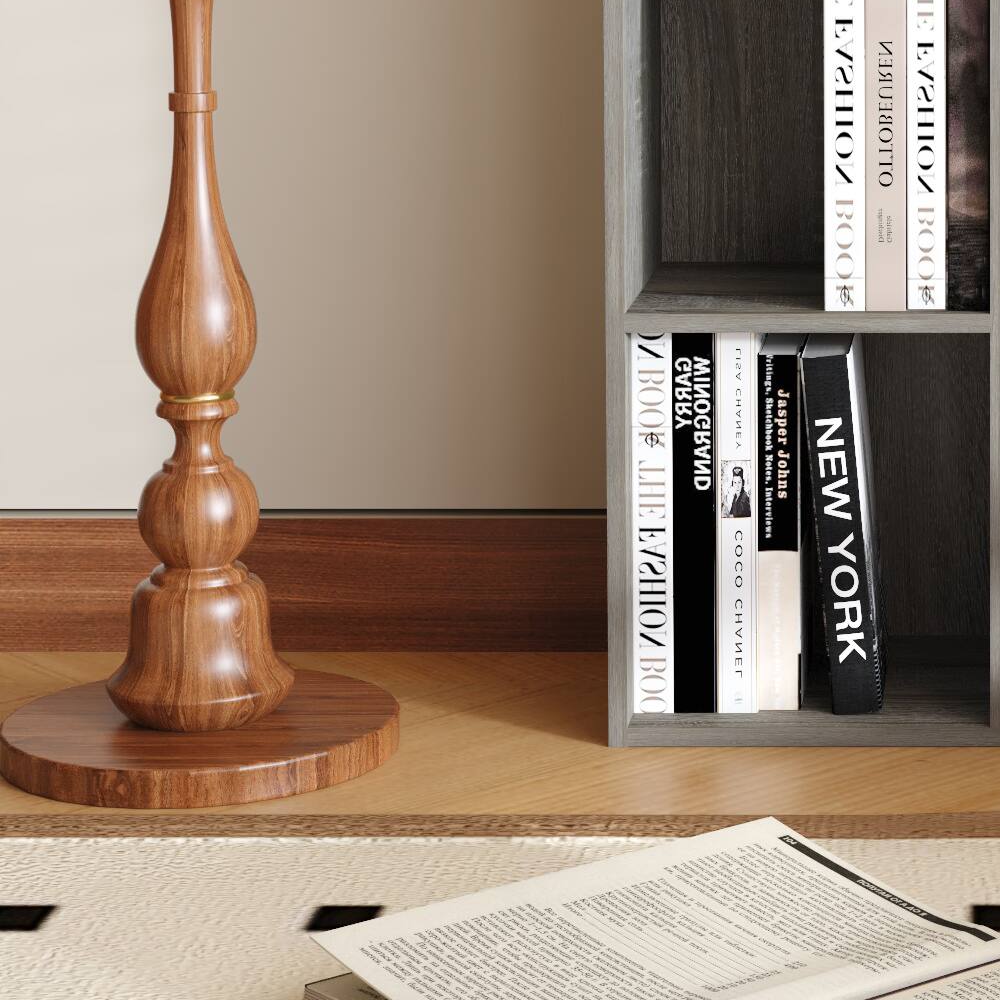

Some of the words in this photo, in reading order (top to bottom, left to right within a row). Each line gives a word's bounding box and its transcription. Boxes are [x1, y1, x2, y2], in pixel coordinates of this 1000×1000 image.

[764, 397, 774, 452] Sketchbook
[775, 388, 791, 453] Jasper
[777, 456, 791, 500] Johns
[814, 416, 852, 521] NEW
[764, 487, 774, 539] Interviews
[827, 531, 867, 664] YORK
